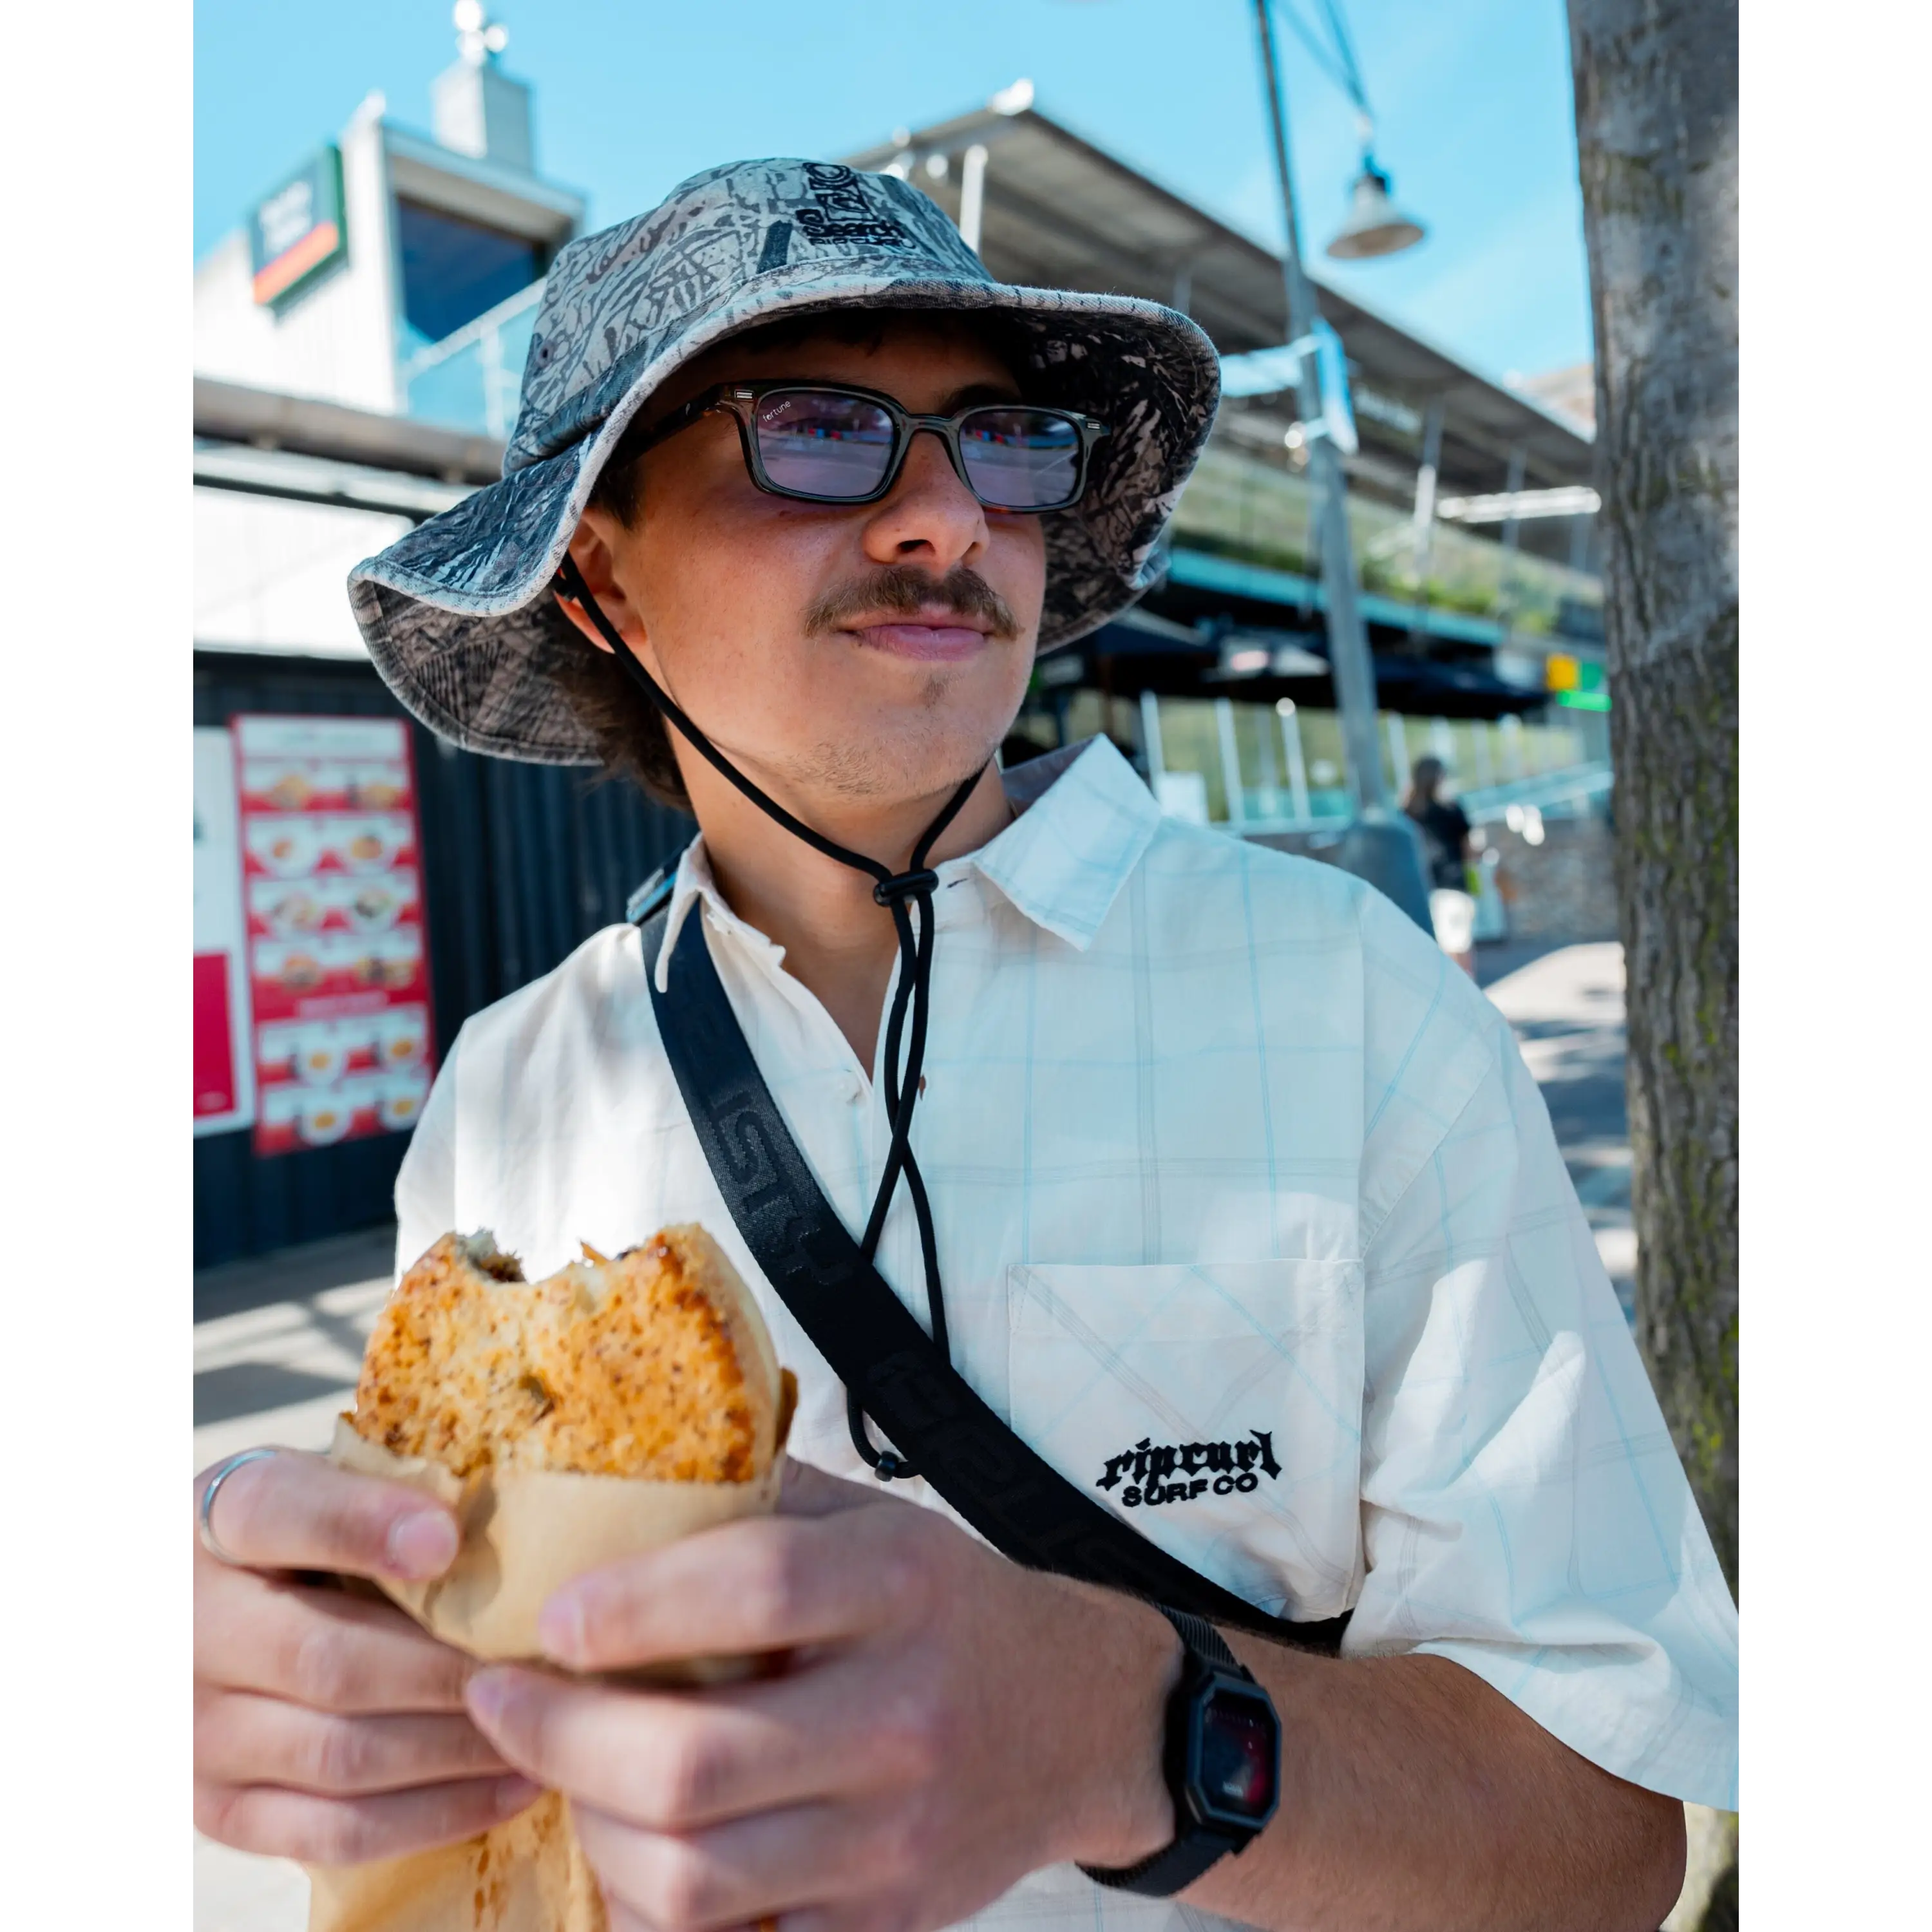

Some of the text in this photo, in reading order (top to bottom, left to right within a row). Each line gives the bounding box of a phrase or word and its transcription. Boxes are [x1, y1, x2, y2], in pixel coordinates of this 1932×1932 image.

[762, 400, 791, 422] fortune
[1122, 1472, 1258, 1508] SURF CO
